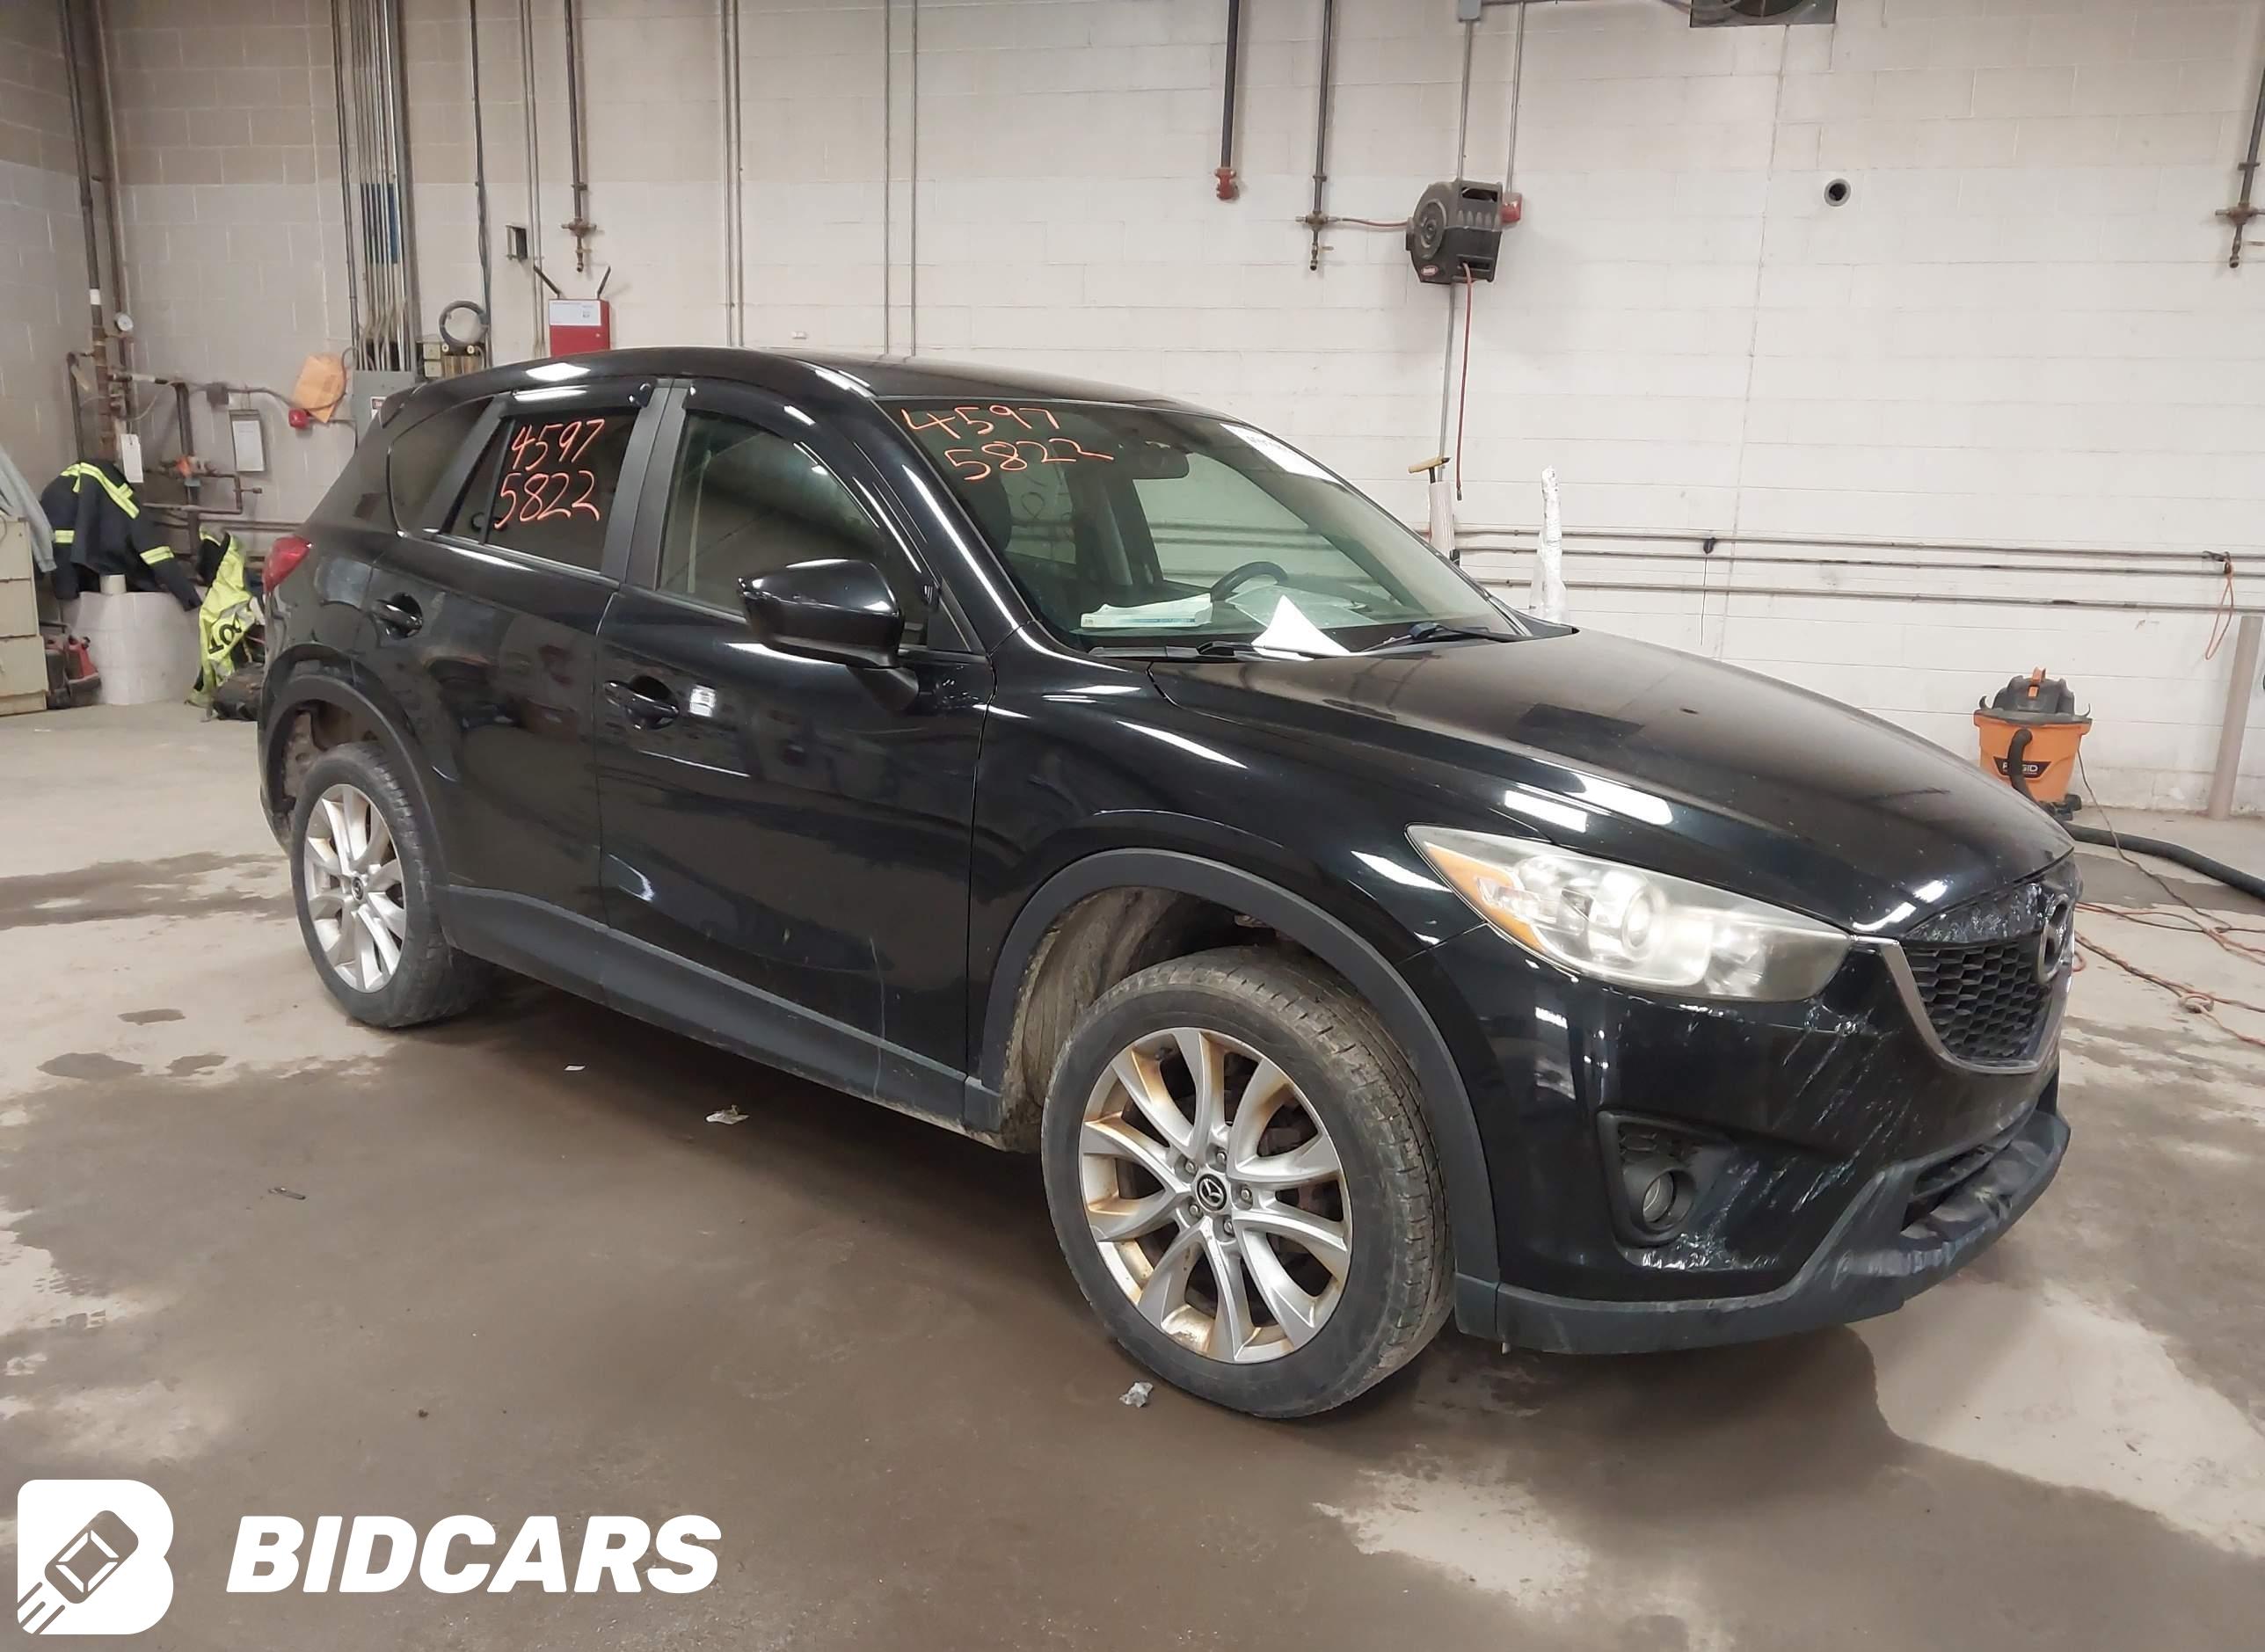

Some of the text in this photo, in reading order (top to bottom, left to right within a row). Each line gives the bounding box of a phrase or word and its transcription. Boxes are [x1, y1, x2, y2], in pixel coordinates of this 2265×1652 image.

[511, 418, 606, 471] 4597
[900, 404, 1060, 440] 4597
[943, 438, 1114, 480] 5822
[493, 469, 601, 529] 5822
